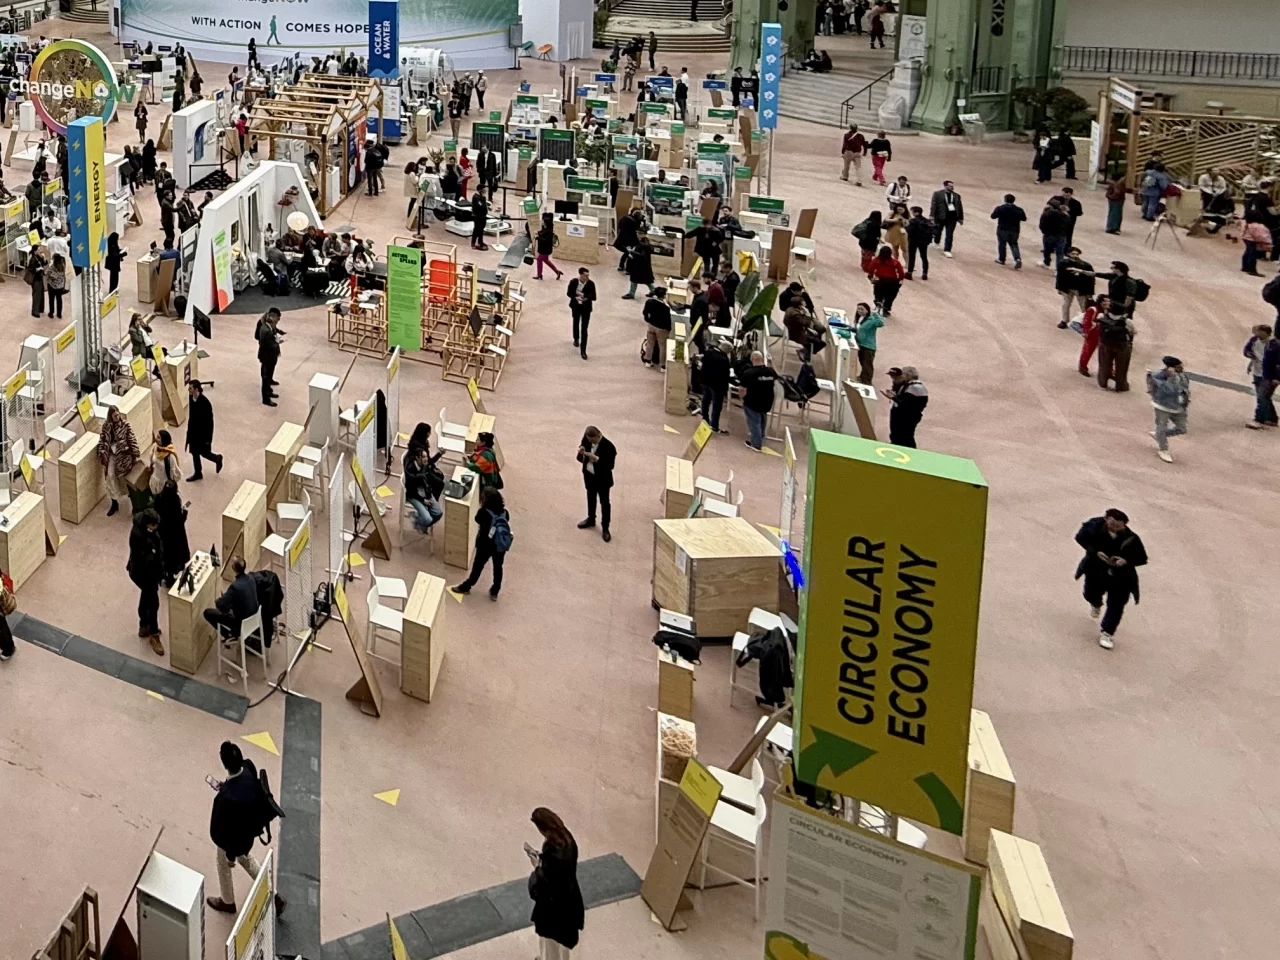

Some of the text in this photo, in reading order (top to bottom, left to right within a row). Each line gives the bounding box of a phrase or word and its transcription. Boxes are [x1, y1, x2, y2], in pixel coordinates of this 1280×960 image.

[191, 16, 262, 30] WITH ACTION
[285, 22, 369, 34] COMES HOPE
[374, 23, 382, 55] OCEAN
[382, 20, 391, 51] WATER
[92, 161, 101, 223] ENERGY
[837, 535, 886, 725] CIRCULAR
[887, 544, 938, 746] ECONOMY
[789, 816, 843, 843] CIRCULAR
[845, 839, 908, 867] ECONOMY?
